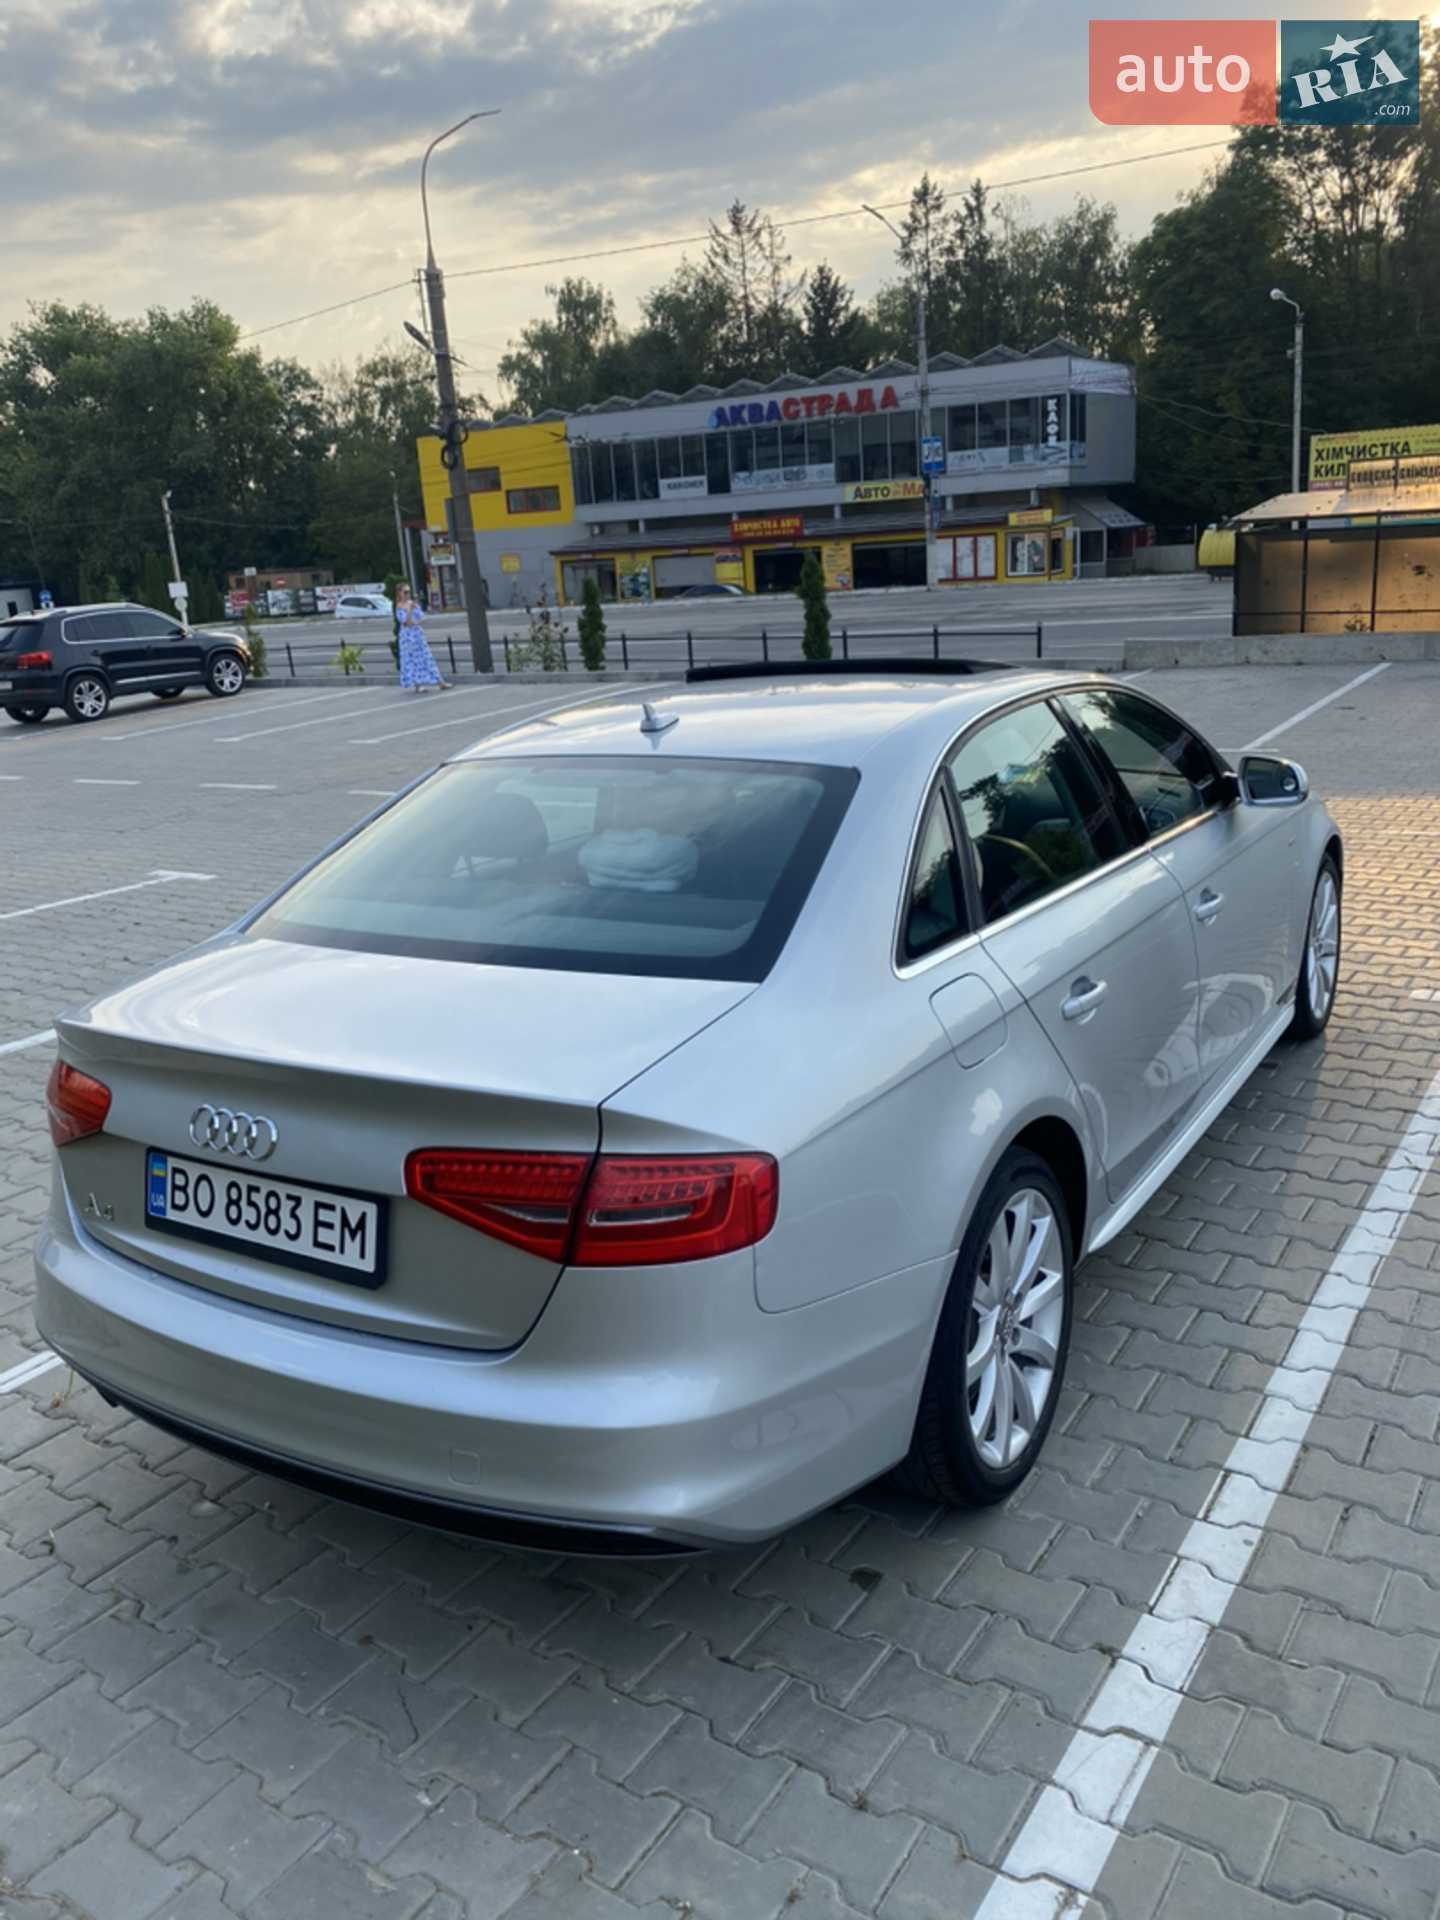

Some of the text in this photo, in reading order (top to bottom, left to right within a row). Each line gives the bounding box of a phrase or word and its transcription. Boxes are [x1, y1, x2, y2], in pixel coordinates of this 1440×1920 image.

[715, 385, 899, 428] АКВАСТРАДА
[1315, 441, 1411, 462] ХІМЧИСТКА
[1314, 463, 1346, 478] КИЛ
[84, 1192, 115, 1222] A4
[151, 1192, 165, 1209] UA
[170, 1166, 367, 1260] BO 8583 EM
